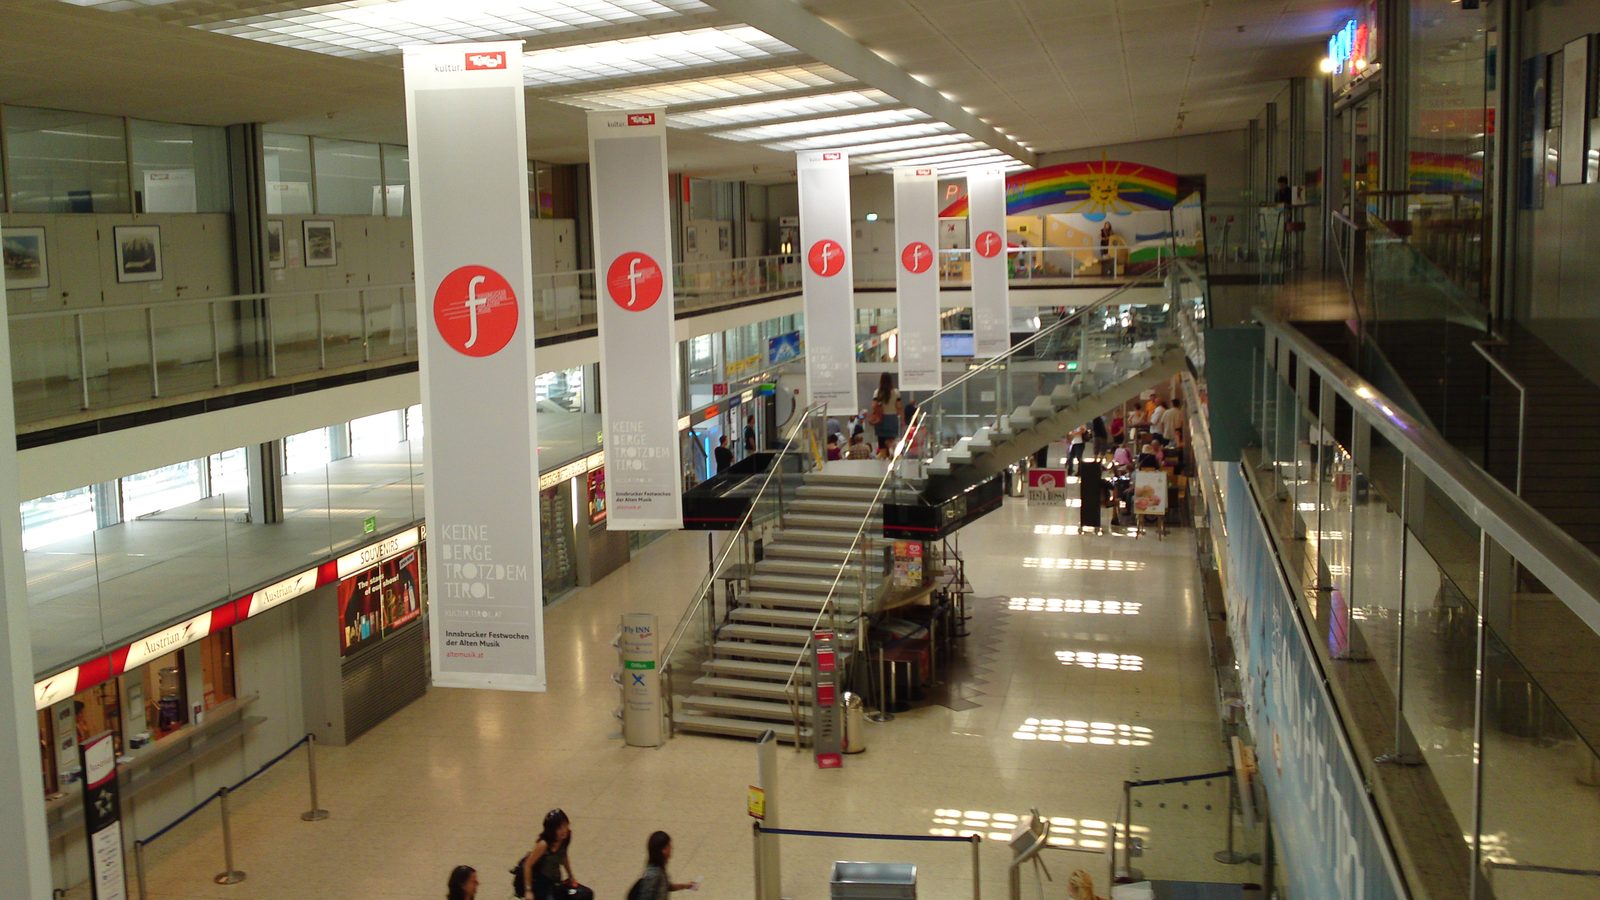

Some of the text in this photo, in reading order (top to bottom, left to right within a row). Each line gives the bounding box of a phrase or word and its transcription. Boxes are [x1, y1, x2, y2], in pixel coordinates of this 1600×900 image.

[434, 64, 463, 73] kultur.
[627, 257, 642, 307] f
[463, 274, 486, 349] f
[441, 523, 489, 541] KEINE
[360, 538, 399, 565] SOUVENIRS
[442, 543, 492, 561] BERGE
[443, 562, 527, 581] TROTZDEM
[358, 573, 384, 590] The stars
[364, 586, 371, 596] of
[382, 573, 399, 588] show!
[263, 584, 293, 605] Austrian
[444, 582, 495, 600] TIROL
[143, 632, 180, 656] Austrian
[445, 630, 530, 640] Innsbrucker Festwochen
[446, 639, 500, 648] der Alten Musik
